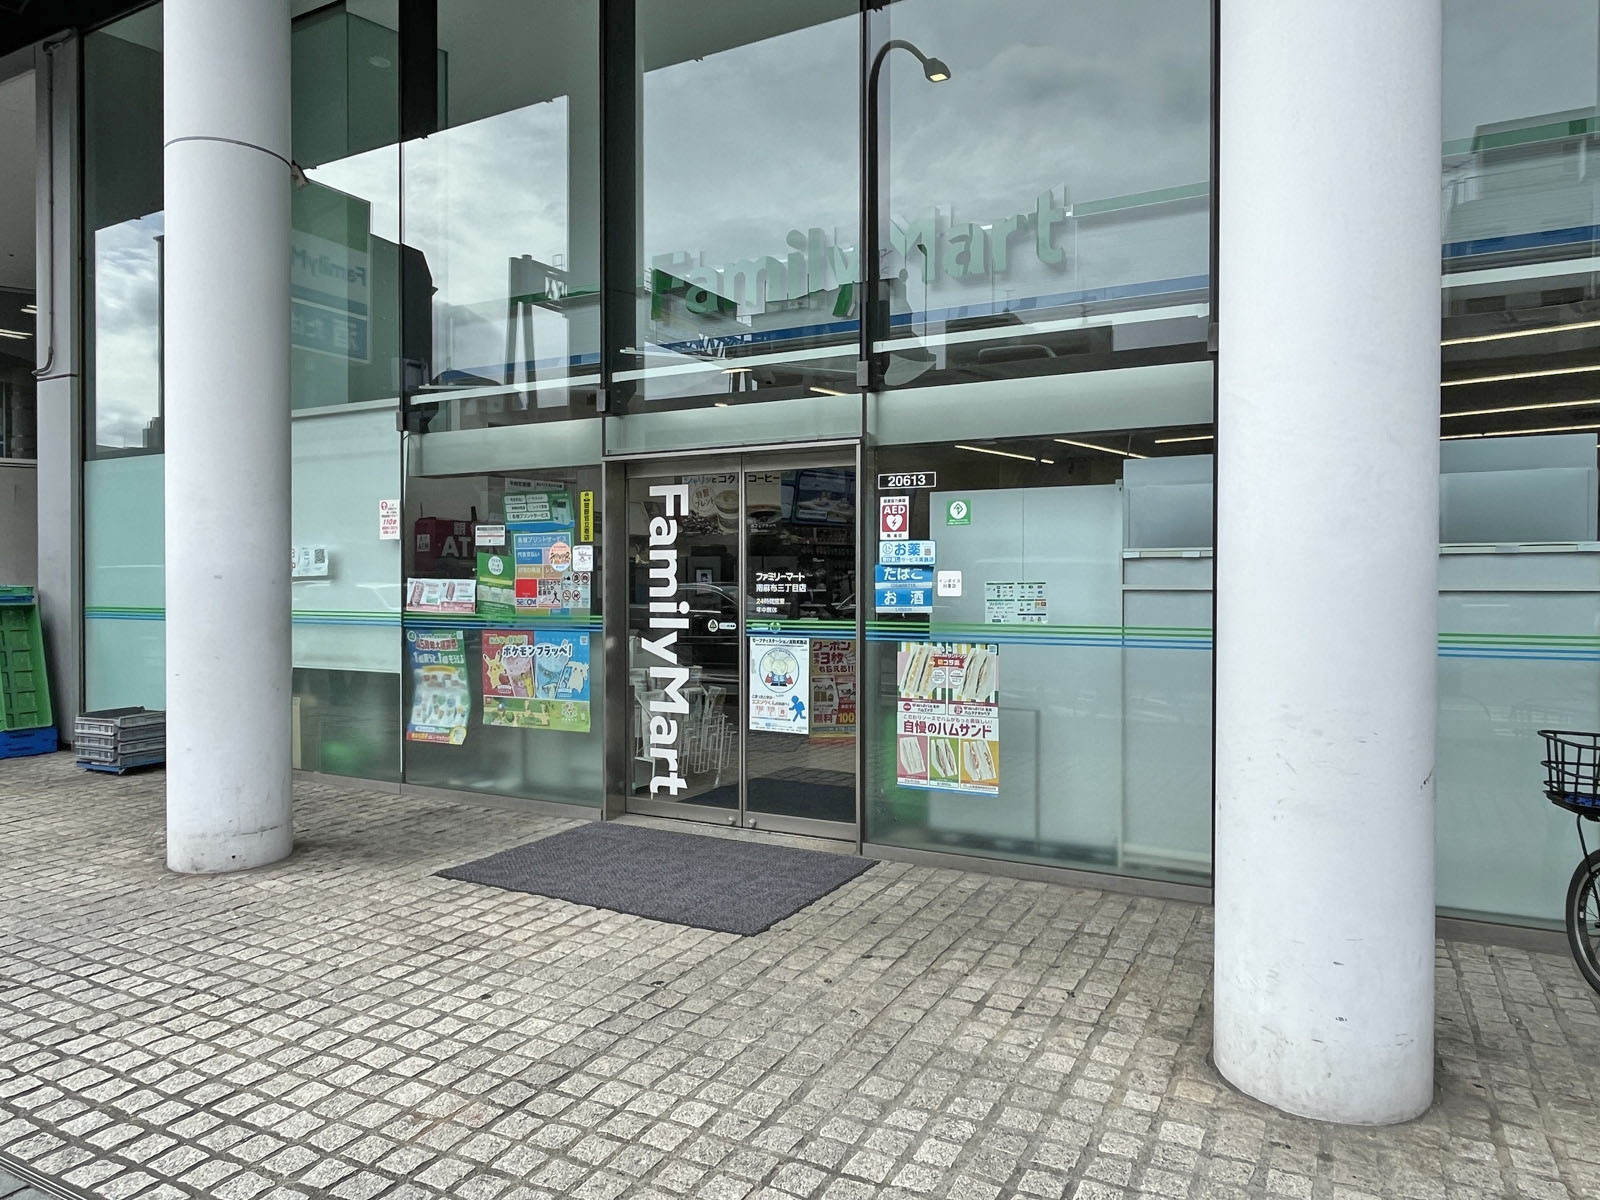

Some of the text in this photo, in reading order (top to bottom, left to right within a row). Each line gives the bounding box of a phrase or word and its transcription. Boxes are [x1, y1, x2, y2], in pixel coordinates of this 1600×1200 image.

[887, 475, 926, 487] 20613
[884, 505, 906, 515] AED
[441, 536, 477, 557] AT
[895, 543, 920, 556] お薬
[756, 572, 805, 581] ファミリーマート
[756, 584, 806, 592] 南麻布三丁目店
[641, 484, 689, 796] FamilyMart
[813, 641, 850, 651] クーポン
[503, 643, 572, 656] ポケモンフラッペ!
[903, 720, 992, 739] 自慢のハムサンド
